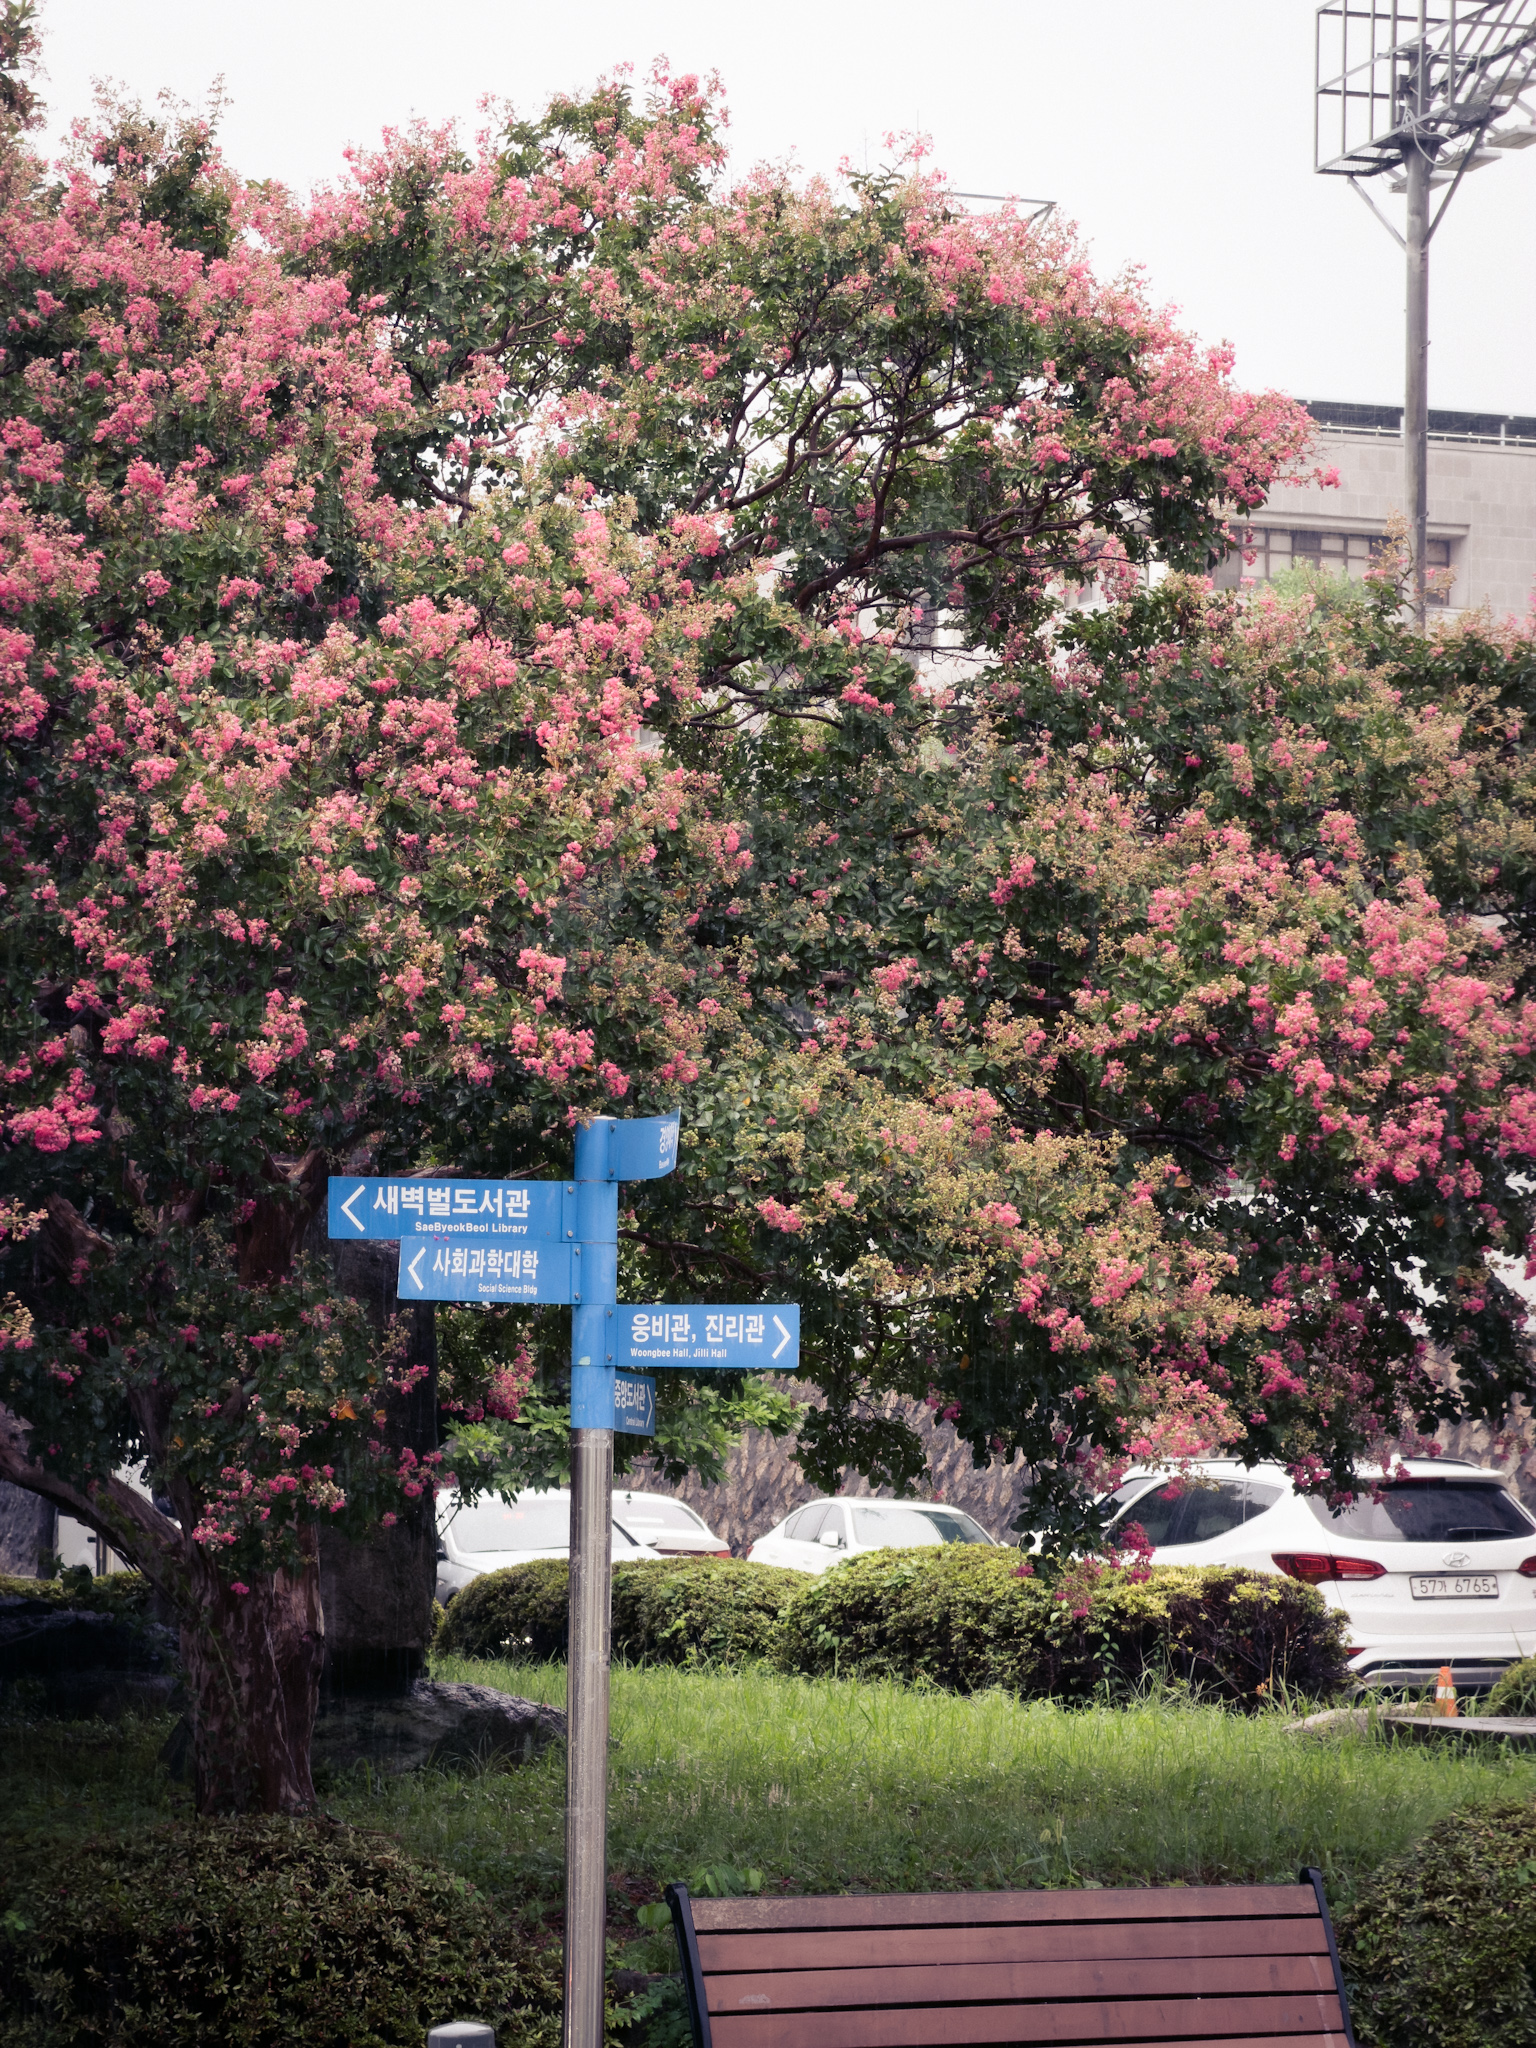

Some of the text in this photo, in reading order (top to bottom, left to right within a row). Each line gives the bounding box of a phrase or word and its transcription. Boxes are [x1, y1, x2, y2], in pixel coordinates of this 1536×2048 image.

[373, 1185, 531, 1218] 새벽벌도서관
[415, 1221, 528, 1234] SaeByeokBeol Library
[432, 1247, 539, 1280] 사회과학대학
[478, 1282, 538, 1295] Social Science Bldg
[631, 1313, 765, 1343] 웅비관, 진리관
[630, 1347, 727, 1359] Woongbee Hall, Jilli Hall
[615, 1379, 646, 1411] 중앙도서관
[1454, 1578, 1490, 1593] 6765
